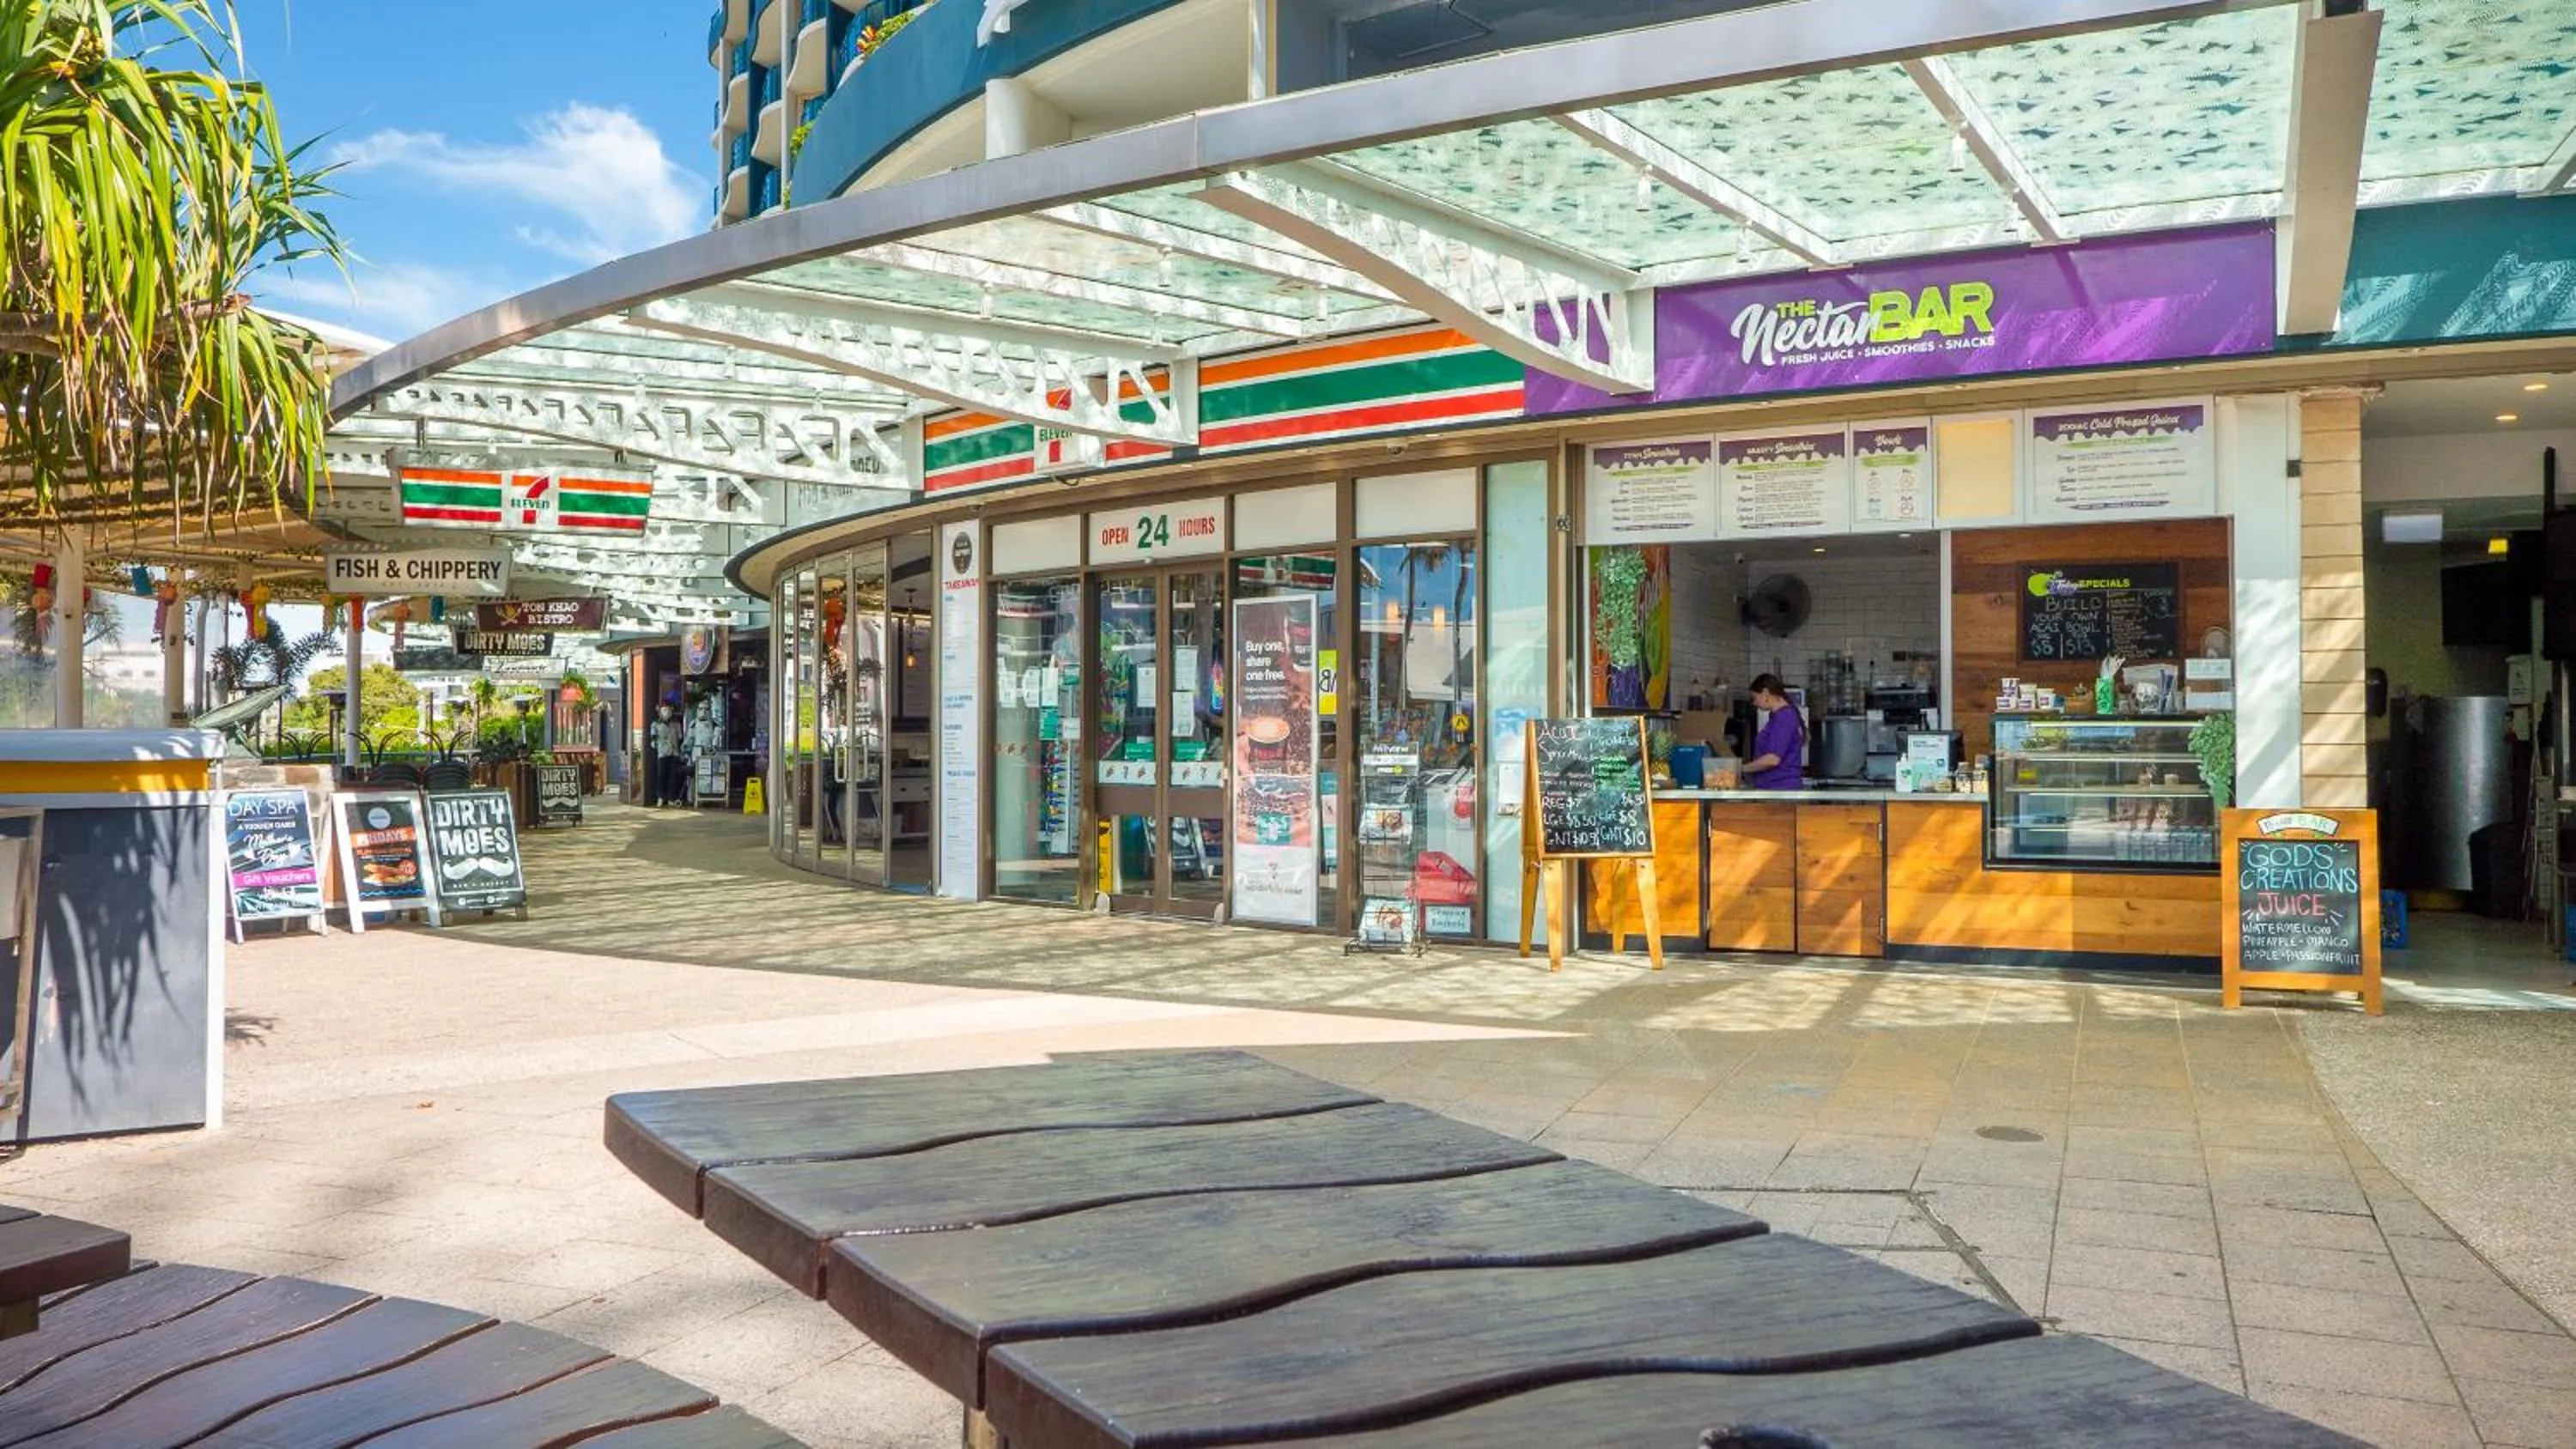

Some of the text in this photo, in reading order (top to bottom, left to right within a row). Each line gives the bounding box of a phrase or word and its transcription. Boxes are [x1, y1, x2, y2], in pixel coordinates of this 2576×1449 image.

[1777, 300, 1816, 318] THE
[1730, 282, 1995, 367] Nectar BAR
[1782, 336, 1996, 366] FRESH JUICE SMOOTHIES SNACKS
[510, 498, 550, 510] ELEVEN
[1102, 514, 1216, 549] OPEN 24 HOURS
[336, 559, 503, 580] FISH & CHIPPERY
[2079, 578, 2130, 589] SPECIALS
[521, 602, 580, 613] TON KHAO
[2045, 597, 2104, 613] BUILD
[528, 614, 574, 625] BISTRO
[2065, 621, 2100, 634] BOWL
[465, 632, 546, 652] DIRTY MOES
[1246, 640, 1262, 653] Buy
[1246, 656, 1272, 667] share
[1246, 672, 1264, 681] one
[541, 768, 576, 781] DIRTY
[542, 782, 577, 797] MOES
[228, 799, 299, 816] DAY SPA
[434, 797, 506, 827] DIRTY
[439, 826, 511, 856] MOES
[1624, 828, 1647, 846] $10
[2247, 843, 2334, 870] GODS
[2240, 867, 2358, 894] CREATIONS
[2257, 892, 2327, 917] JUICE
[2242, 935, 2300, 948] PINEAPPLE
[2306, 937, 2349, 949] MANGO
[2244, 949, 2280, 961] APPLE
